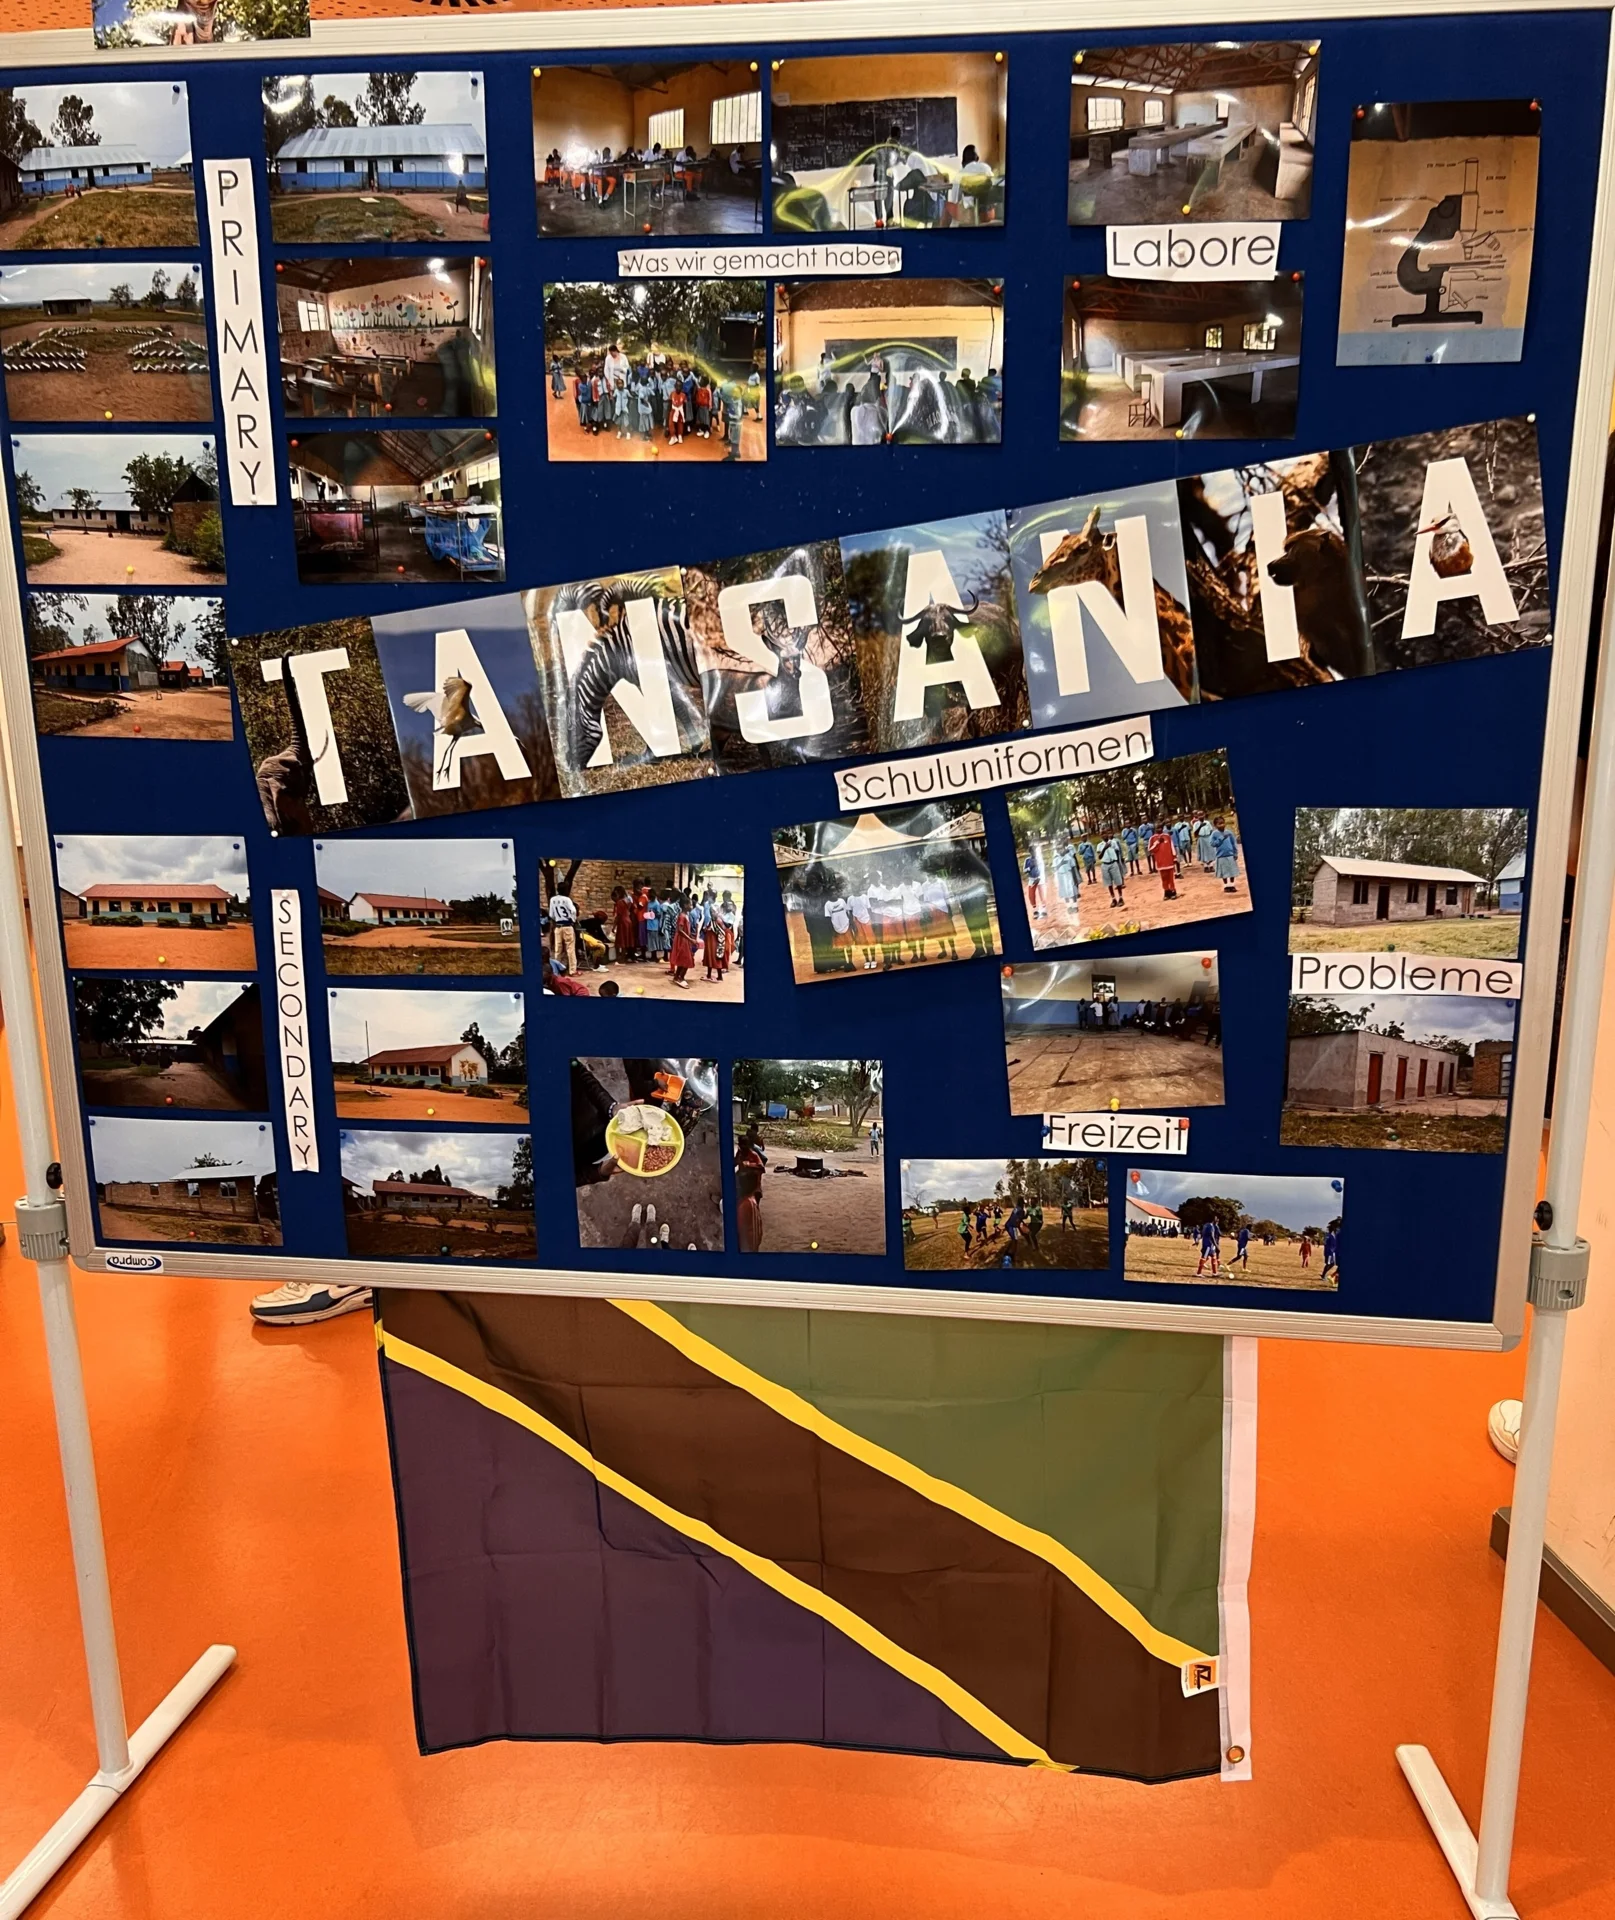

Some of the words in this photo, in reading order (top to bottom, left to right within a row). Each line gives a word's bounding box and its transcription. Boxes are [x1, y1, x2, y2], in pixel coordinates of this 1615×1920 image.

[624, 254, 669, 273] Was
[677, 251, 707, 270] wir
[713, 248, 817, 275] gemacht
[825, 246, 900, 267] haben
[1113, 229, 1275, 268] Labore
[217, 170, 261, 496] PRIMARY
[260, 456, 1520, 806] TANSANIA
[842, 731, 1149, 804] Schuluniformen
[555, 906, 569, 918] 13
[1299, 956, 1513, 994] Probleme
[278, 899, 311, 1165] SECONDARY
[1049, 1115, 1187, 1151] Freizeit
[112, 1255, 155, 1267] compra
